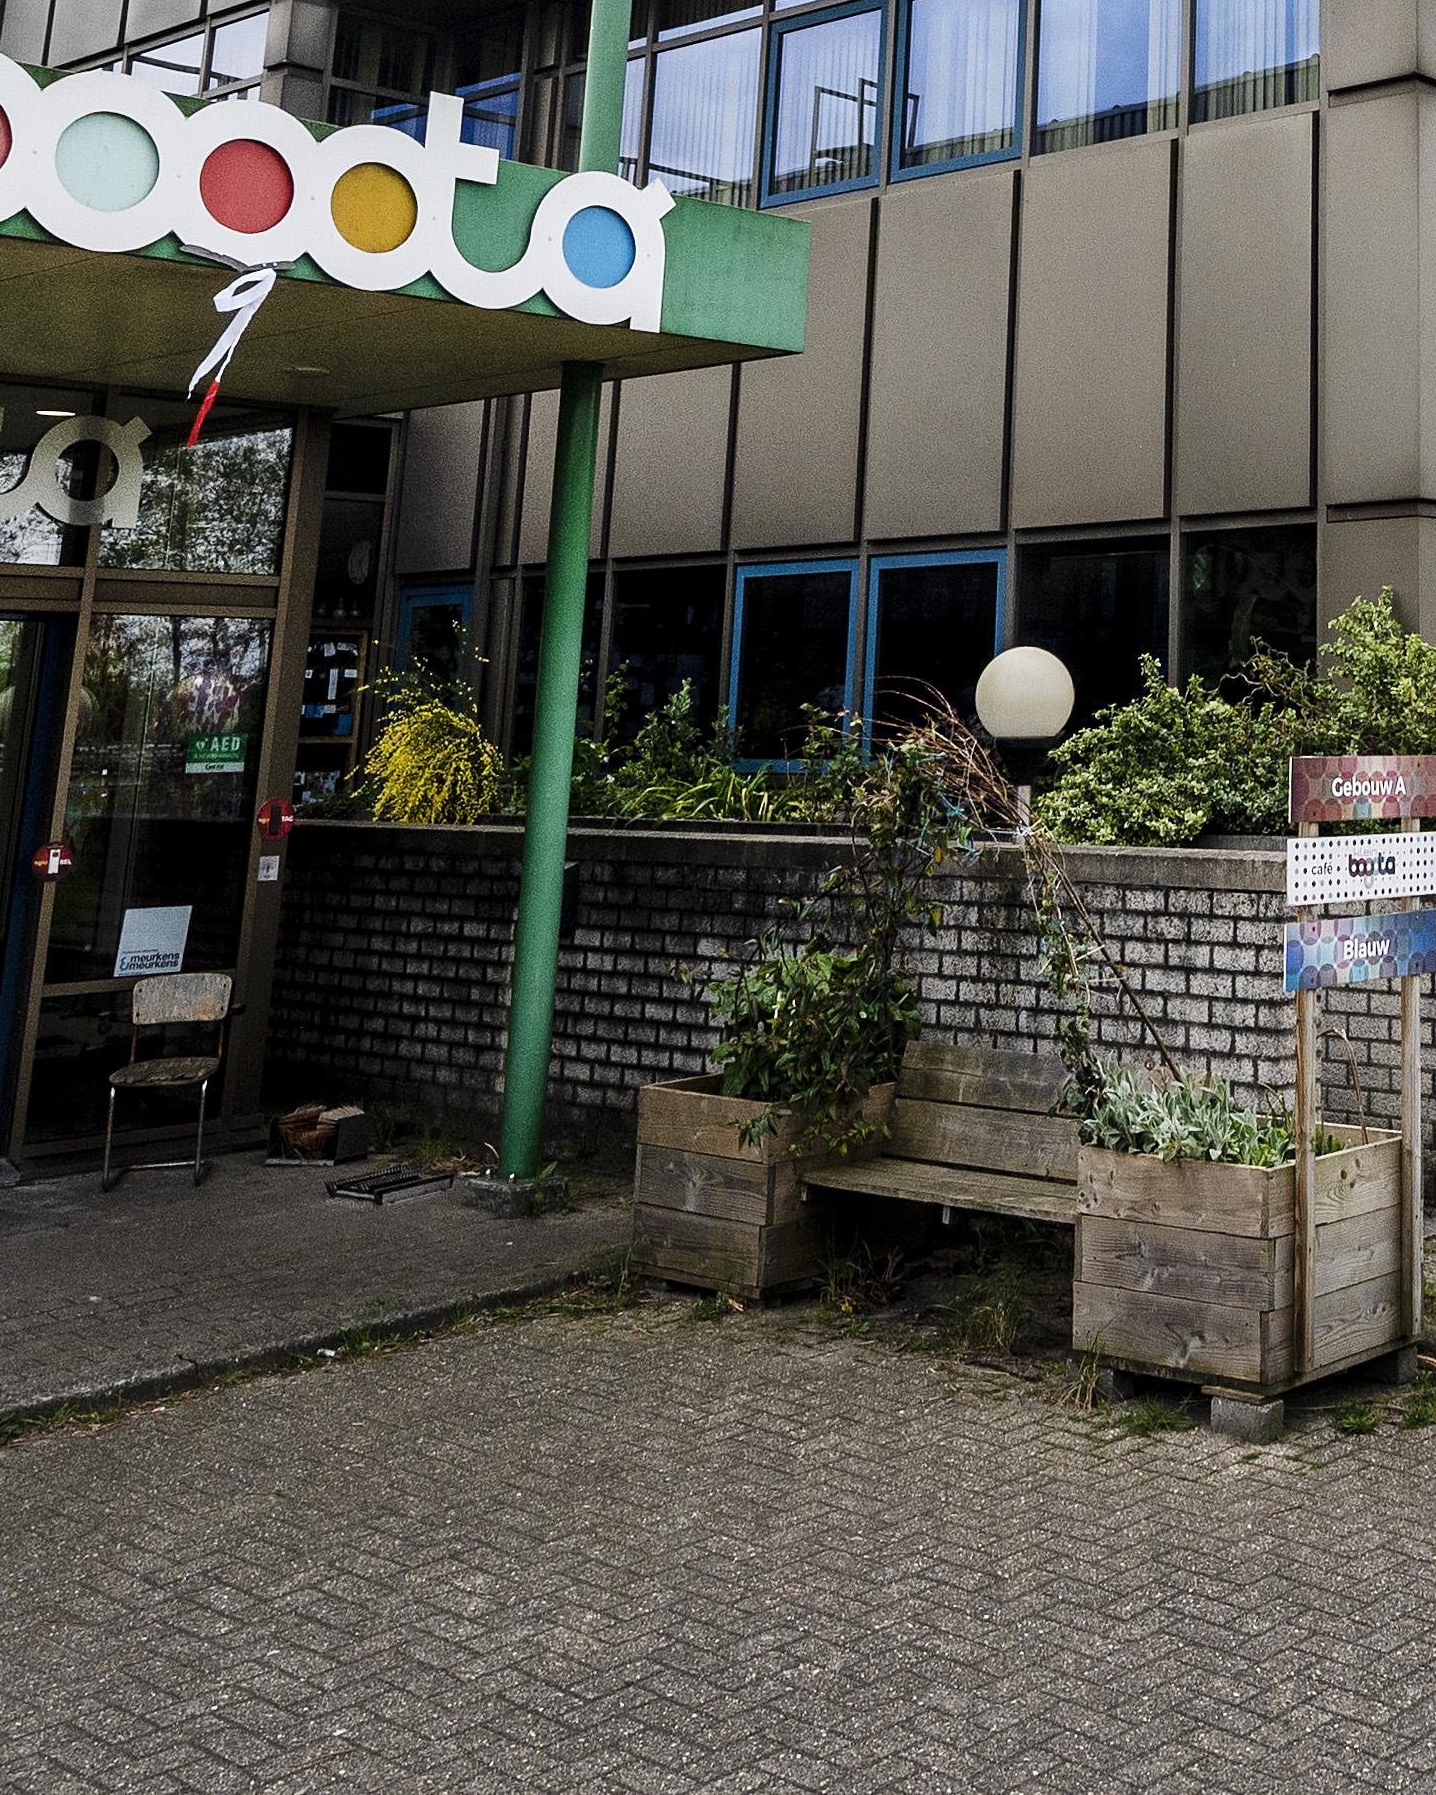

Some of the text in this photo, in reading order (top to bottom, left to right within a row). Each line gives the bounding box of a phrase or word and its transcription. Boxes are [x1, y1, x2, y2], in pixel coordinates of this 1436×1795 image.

[210, 736, 241, 752] AED
[1331, 775, 1407, 797] Gebouw A
[1311, 862, 1333, 875] café
[1343, 938, 1390, 960] Blauw
